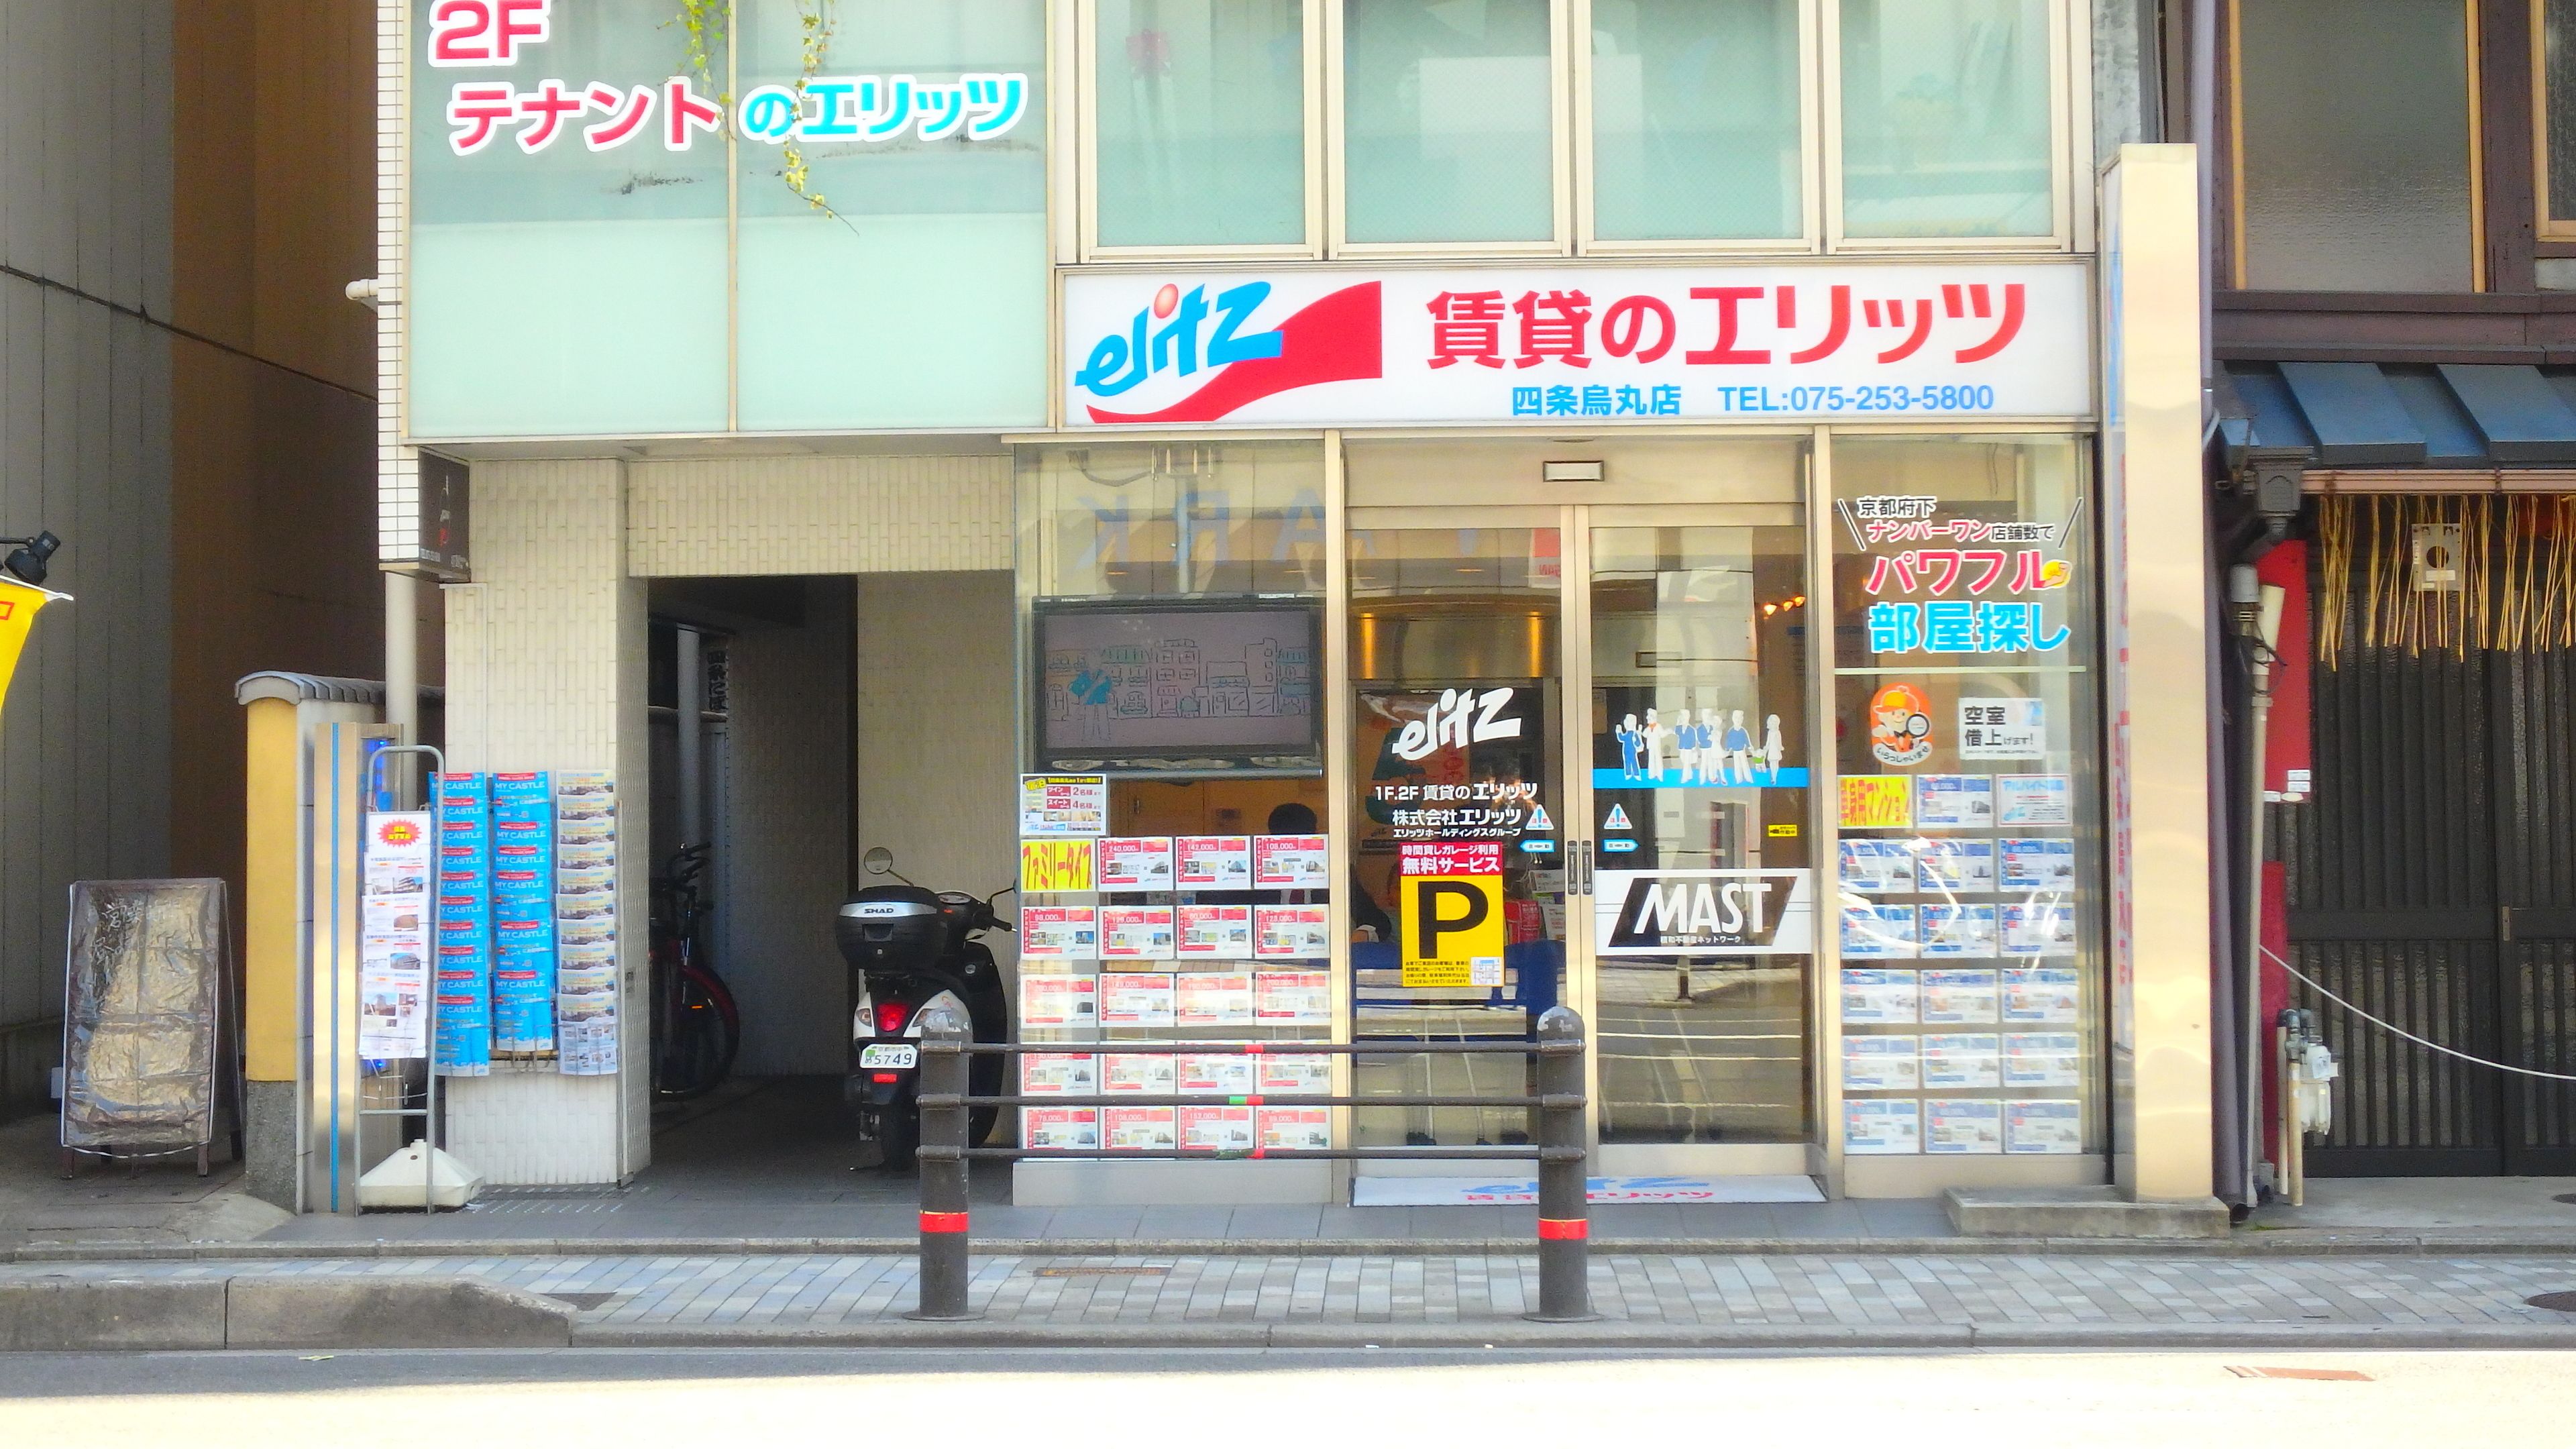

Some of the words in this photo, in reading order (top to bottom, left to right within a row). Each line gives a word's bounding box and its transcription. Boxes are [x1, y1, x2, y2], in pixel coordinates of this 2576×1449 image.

[435, 0, 545, 62] 2F
[1426, 284, 2026, 370] 賃貸のエリッツ
[1075, 281, 1283, 397] elitz
[1512, 385, 1681, 416] 四条烏丸店
[1718, 386, 1994, 413] TEL:075-253-5800
[1858, 498, 1935, 517] 京都府下
[1868, 551, 2053, 594] パワフル
[1870, 602, 2070, 652] 部屋探し
[1964, 705, 2006, 725] 空室
[1392, 688, 1521, 761] elitz
[509, 782, 545, 790] CASTLE
[1375, 786, 1419, 801] 1F.2F
[1423, 782, 1538, 801] 賃貸のエリッツ
[447, 806, 484, 814] CASTLE
[1392, 808, 1521, 826] 株式会社エリッツ
[510, 830, 547, 839] CASTLE
[1393, 828, 1521, 838] エリッツホールディングスグループ
[1402, 845, 1499, 855] 時間貸しガレージ利用
[445, 856, 482, 865] CASTLE
[509, 856, 545, 864] CASTLE
[1022, 843, 1092, 890] ファミリータイプ
[1402, 857, 1501, 875] 無料サービス
[447, 881, 484, 889] CASTLE
[508, 881, 544, 889] CASTLE
[447, 906, 482, 914] CASTLE
[1633, 883, 1772, 934] MAST
[1417, 880, 1489, 959] P
[446, 930, 482, 938] CASTLE
[512, 930, 548, 938] CASTLE
[447, 956, 482, 964] CASTLE
[447, 980, 484, 989] CASTLE
[509, 980, 545, 988] CASTLE
[446, 1006, 482, 1014] CASTLE
[874, 1053, 912, 1065] 5749
